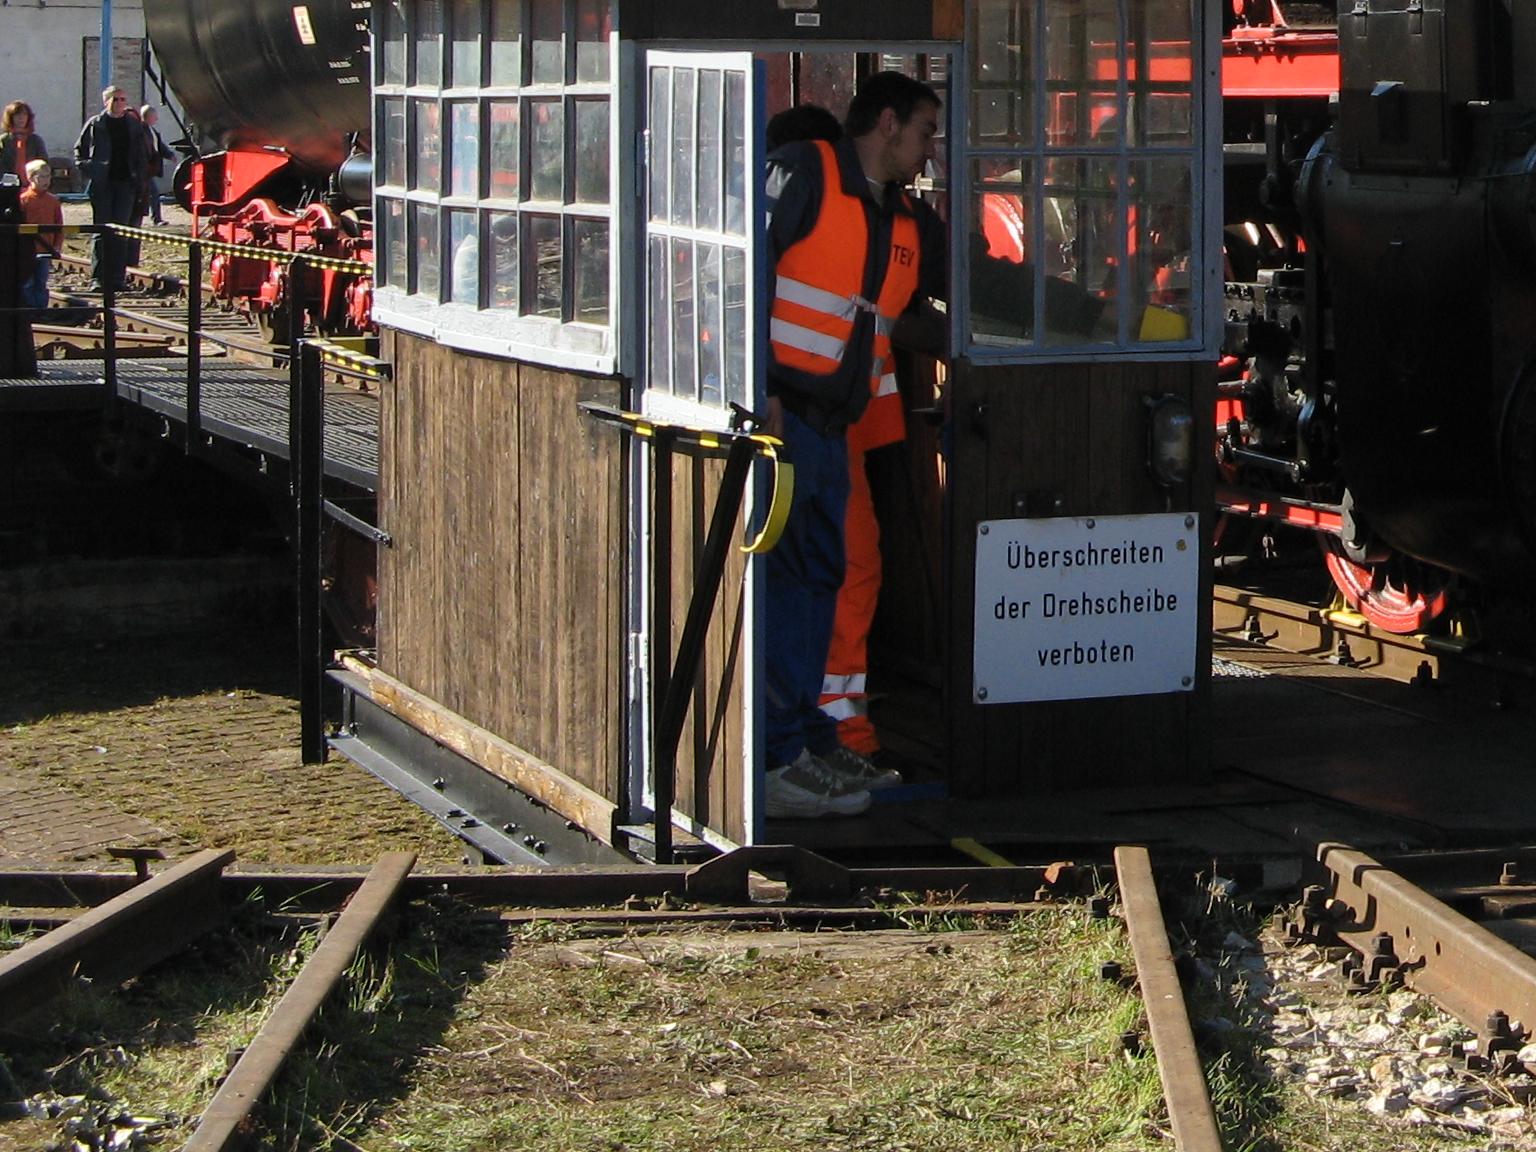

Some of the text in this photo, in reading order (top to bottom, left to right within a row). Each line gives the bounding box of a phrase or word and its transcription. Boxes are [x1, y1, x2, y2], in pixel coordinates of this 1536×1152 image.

[1007, 540, 1164, 570] Überschreiten
[994, 588, 1178, 620] der Drehscheibe
[1037, 639, 1134, 667] verboten
